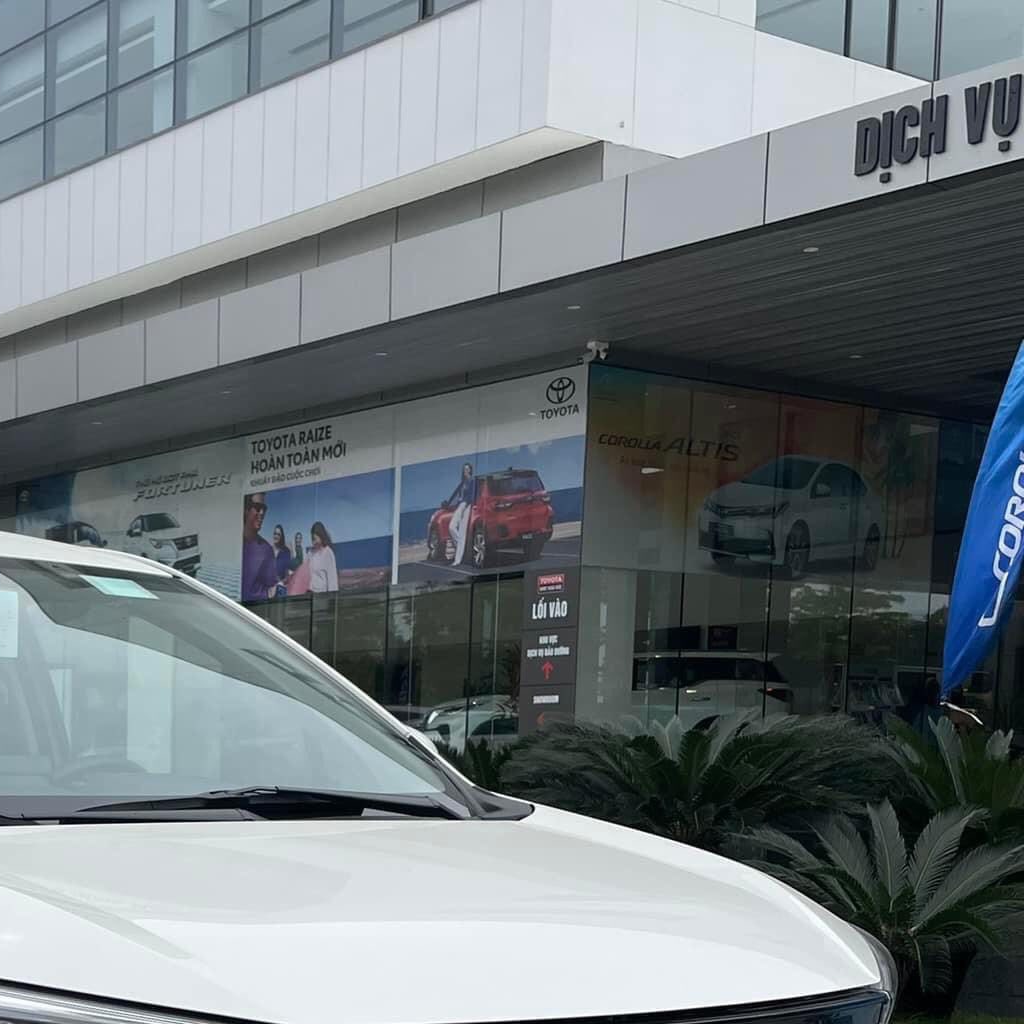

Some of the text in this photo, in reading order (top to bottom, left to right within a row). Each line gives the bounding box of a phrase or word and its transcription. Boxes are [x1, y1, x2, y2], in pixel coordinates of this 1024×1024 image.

[855, 74, 1022, 184] DỊCH VỤ
[540, 404, 580, 420] TOYOTA
[251, 425, 332, 455] TOYOTA RAIZE
[662, 437, 739, 462] ALTIS
[251, 440, 347, 474] HOÀN TOÀN MỚI
[133, 472, 232, 502] FORTUNER
[532, 596, 568, 620] LỐI VÀO
